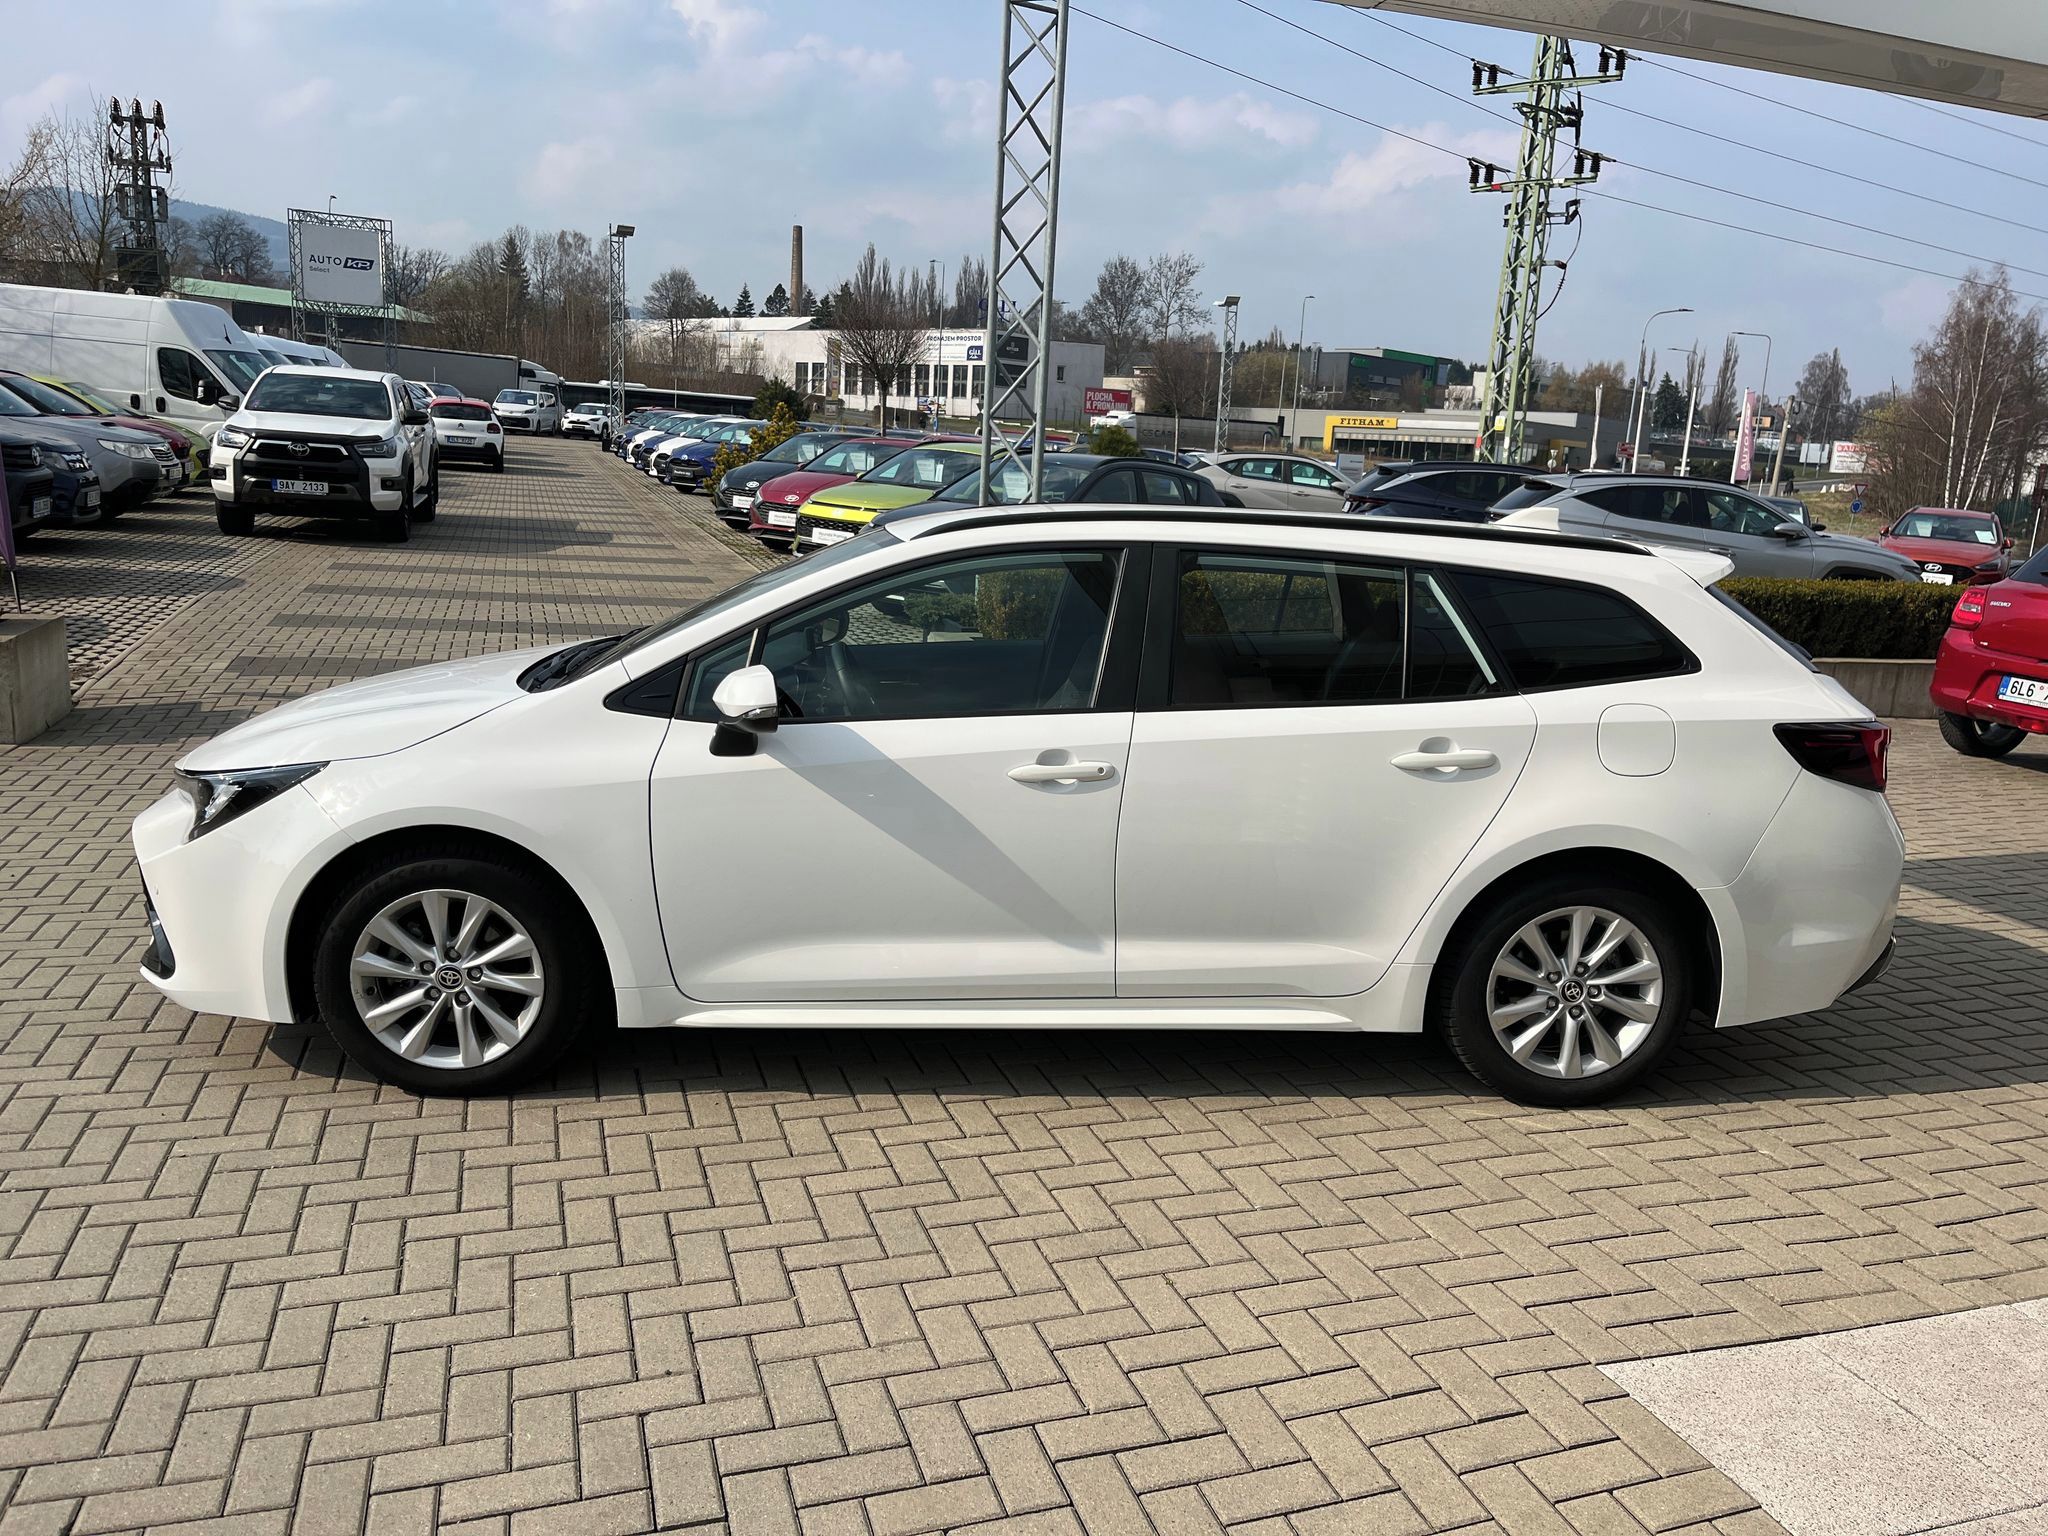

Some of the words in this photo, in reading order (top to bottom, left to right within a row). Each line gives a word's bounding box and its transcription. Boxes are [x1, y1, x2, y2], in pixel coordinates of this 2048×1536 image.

[309, 254, 342, 266] AUTO
[1086, 400, 1092, 410] K
[1340, 418, 1385, 426] FITHAM
[1741, 436, 1749, 471] AUTO
[279, 480, 295, 490] 9AY
[302, 482, 325, 491] 2133
[2010, 680, 2036, 697] 6L6
